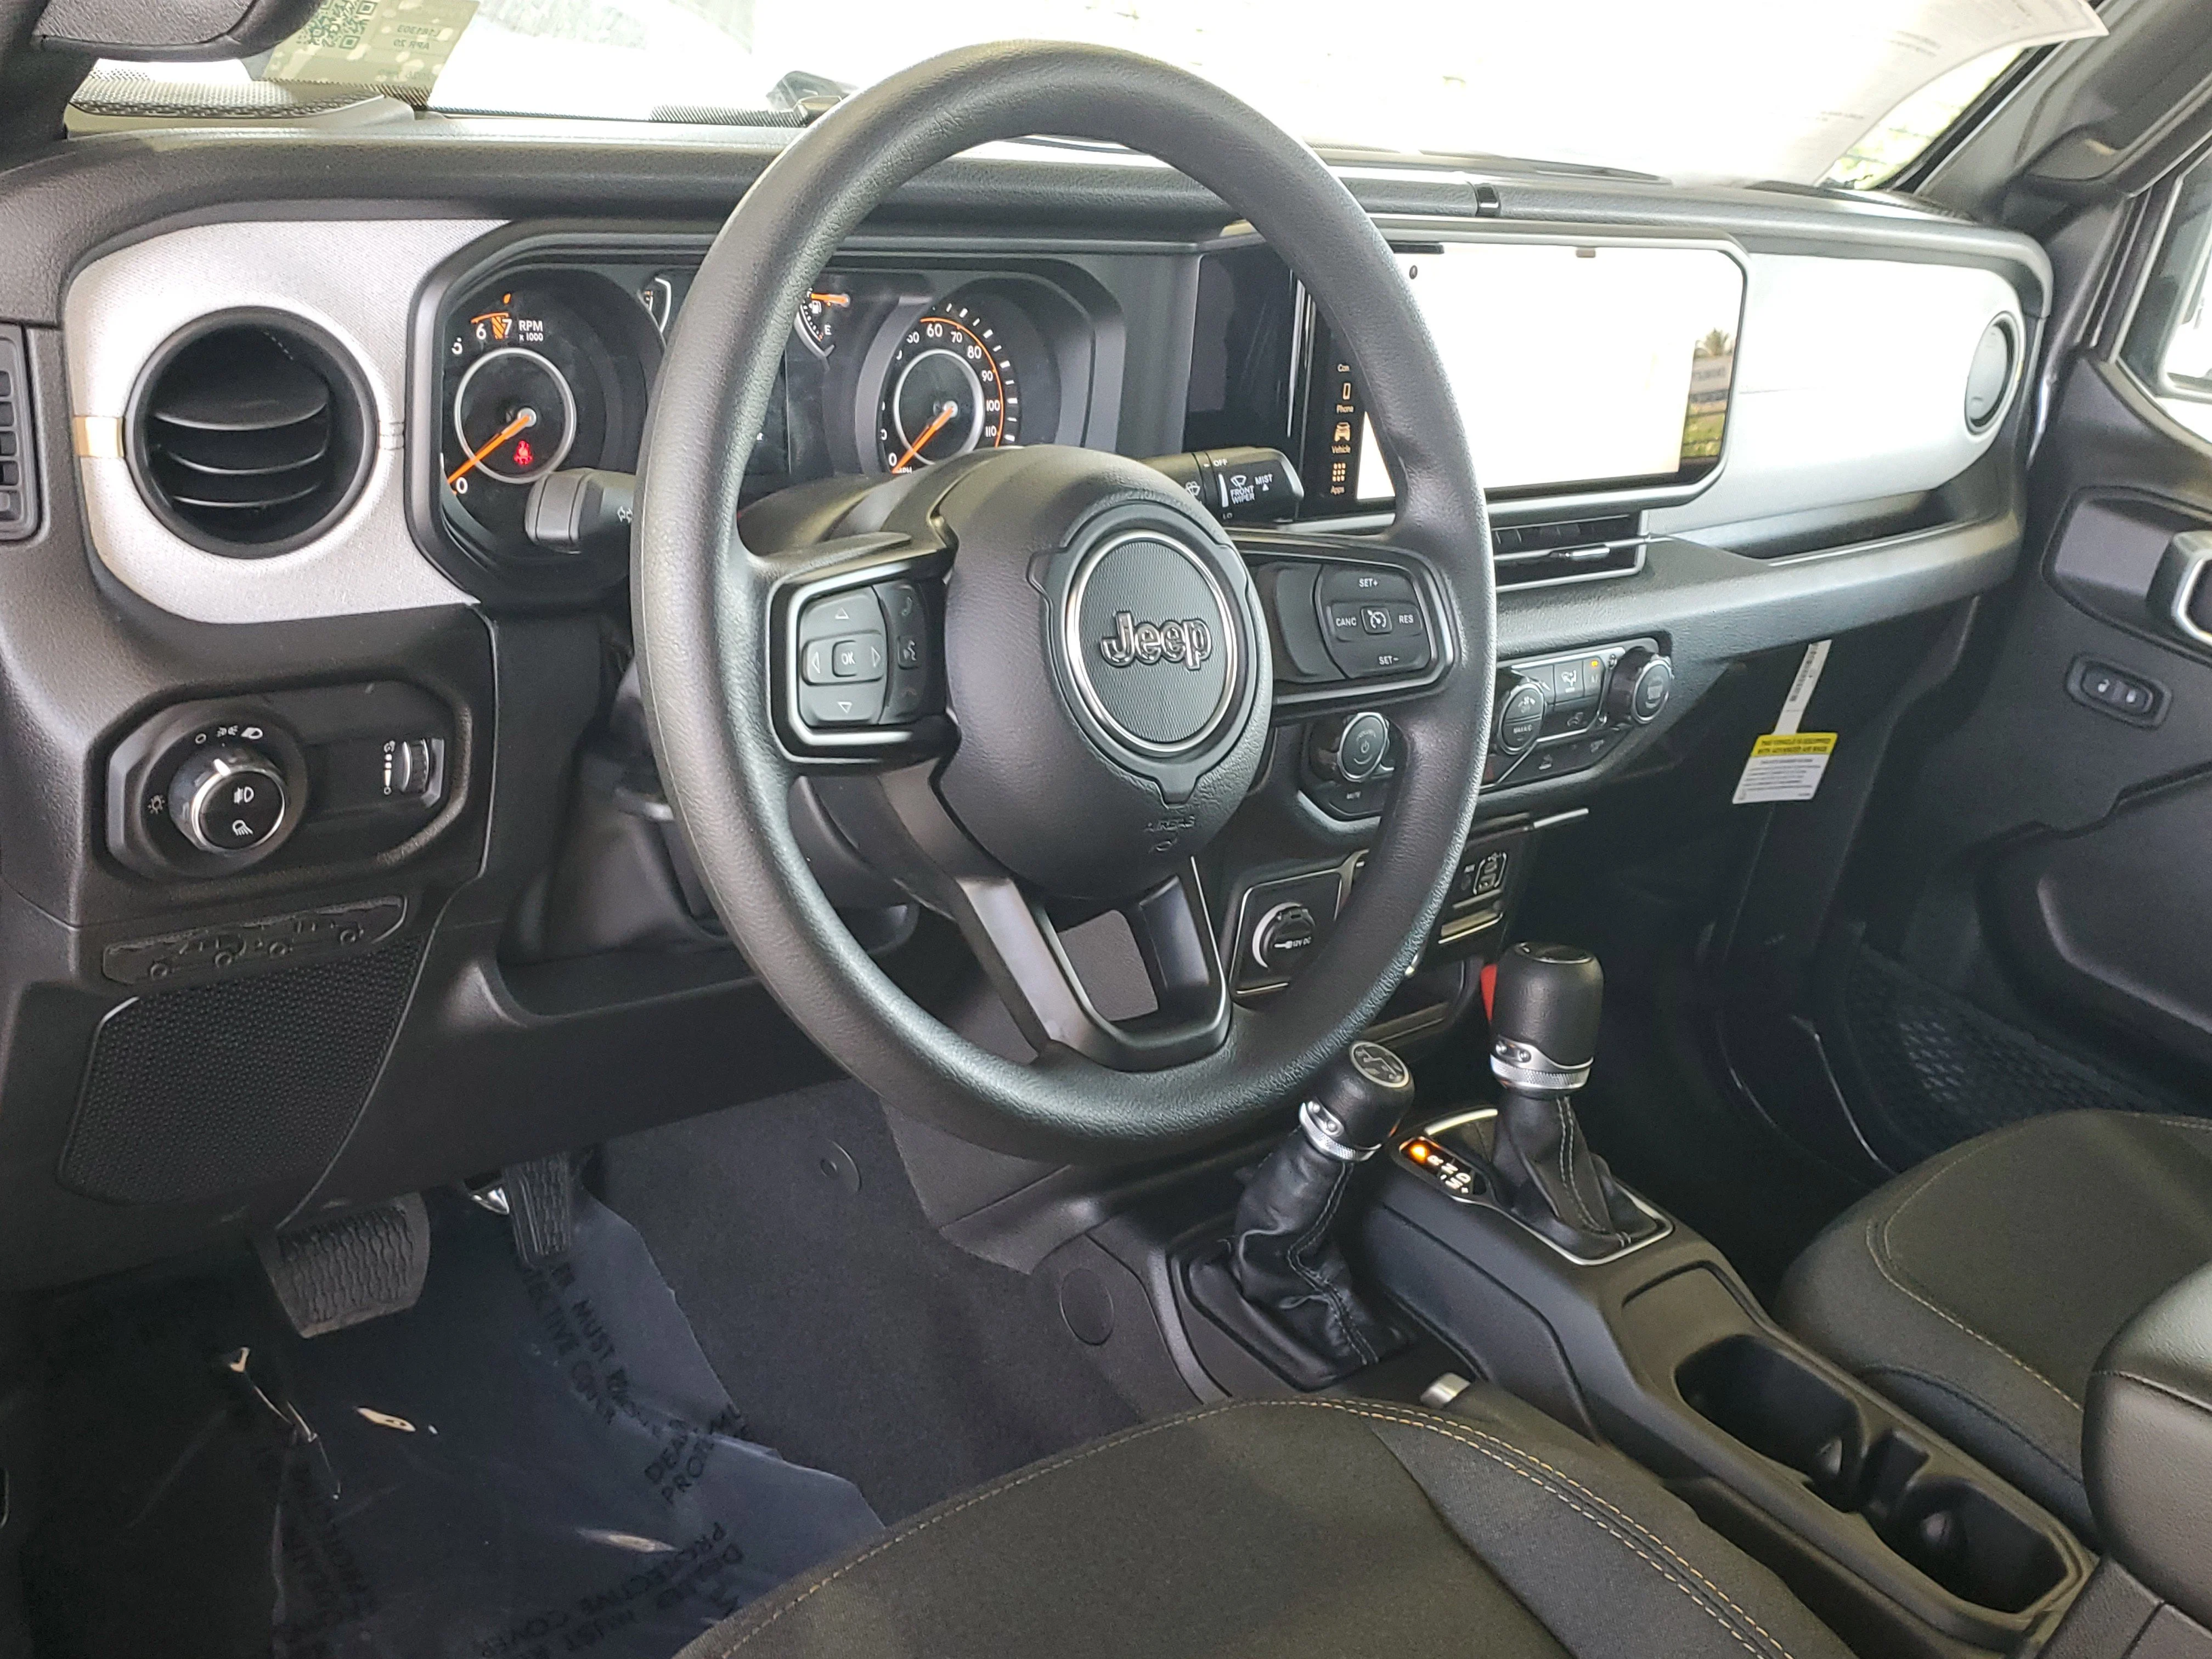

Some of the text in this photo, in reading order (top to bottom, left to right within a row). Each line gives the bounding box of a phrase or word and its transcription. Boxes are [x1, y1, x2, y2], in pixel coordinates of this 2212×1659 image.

[476, 323, 487, 340] 6
[502, 319, 512, 335] 7
[518, 320, 543, 331] RPM
[824, 324, 832, 335] E
[927, 323, 943, 337] 60
[526, 333, 544, 341] 1000
[950, 331, 962, 343] 70
[967, 345, 982, 359] 80
[981, 370, 994, 381] 90
[986, 399, 1000, 411] 100
[985, 425, 997, 437] 110
[889, 452, 897, 466] 0
[1255, 473, 1273, 485] MIST
[456, 477, 468, 494] 0
[1230, 484, 1254, 496] FRONT
[1359, 578, 1378, 588] SET+
[1335, 617, 1357, 627] CANC
[1398, 615, 1414, 624] RES
[1101, 611, 1212, 670] Jeep
[841, 651, 855, 665] OK
[1427, 1155, 1444, 1166] R
[1441, 1163, 1458, 1175] N
[1455, 1172, 1471, 1183] D
